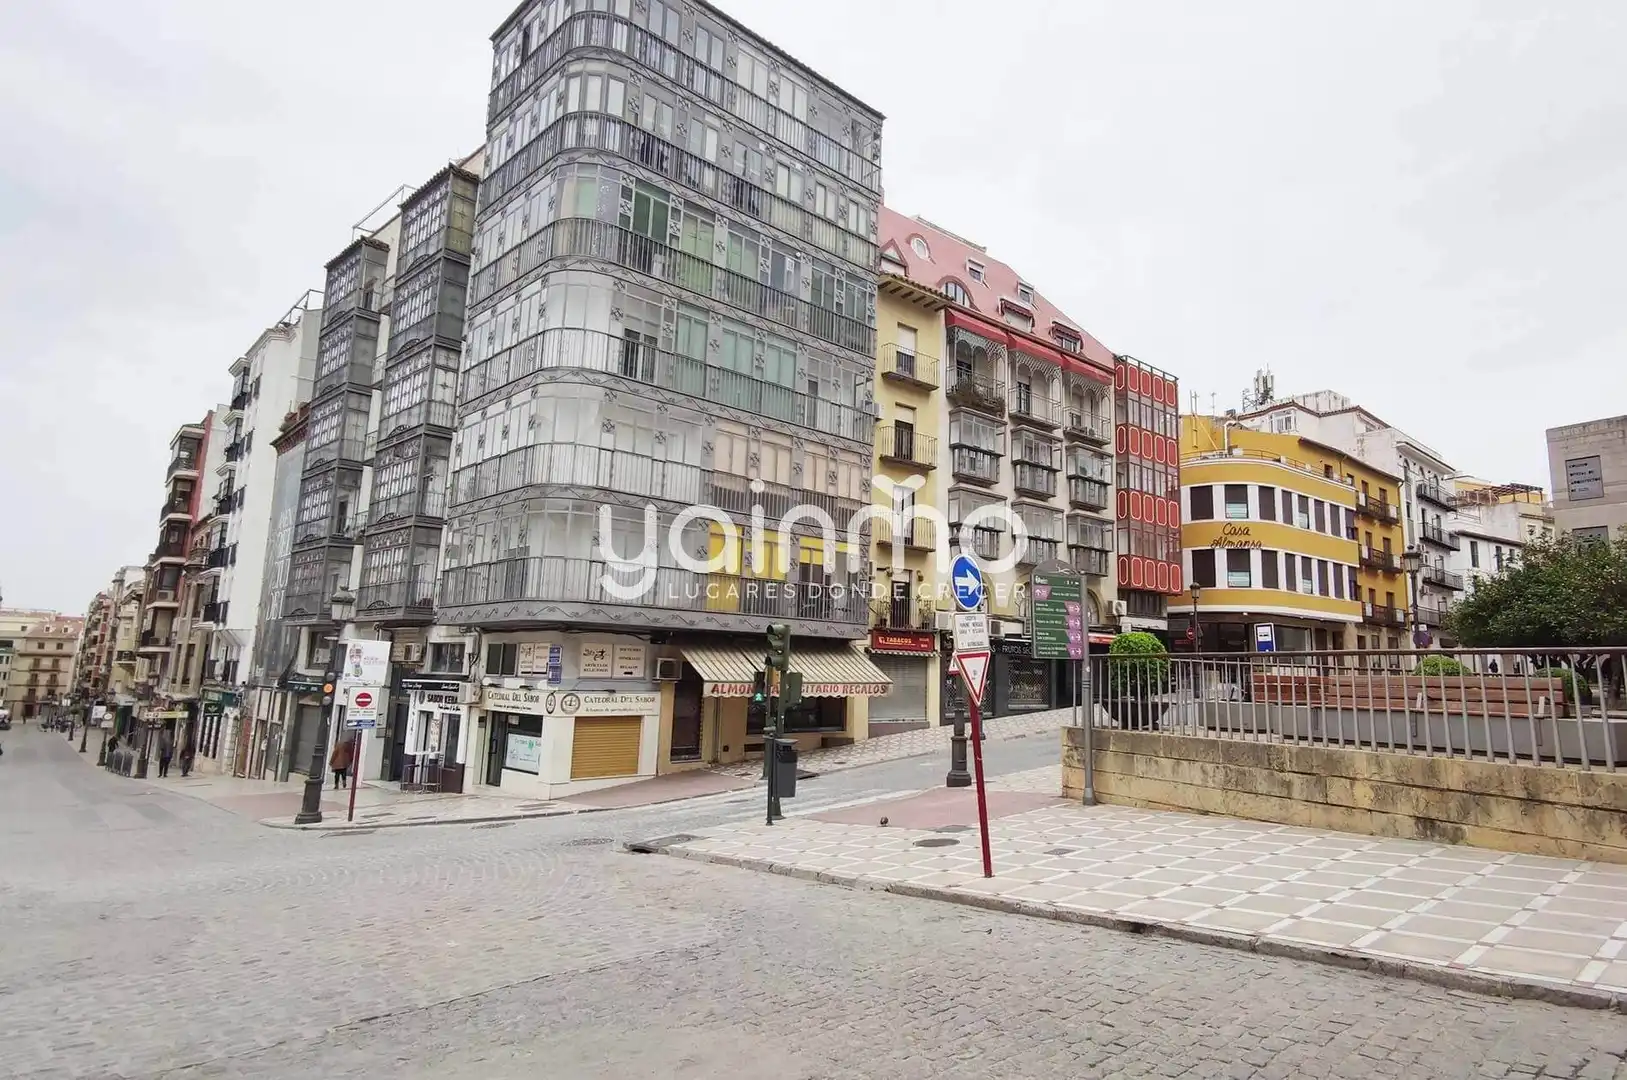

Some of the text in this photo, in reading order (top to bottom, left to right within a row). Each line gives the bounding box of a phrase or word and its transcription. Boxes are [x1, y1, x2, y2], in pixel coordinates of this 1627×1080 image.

[1222, 522, 1251, 536] Casa
[1210, 536, 1263, 549] Almansa
[842, 684, 887, 694] REGALOS
[584, 696, 618, 704] CATEDRAL
